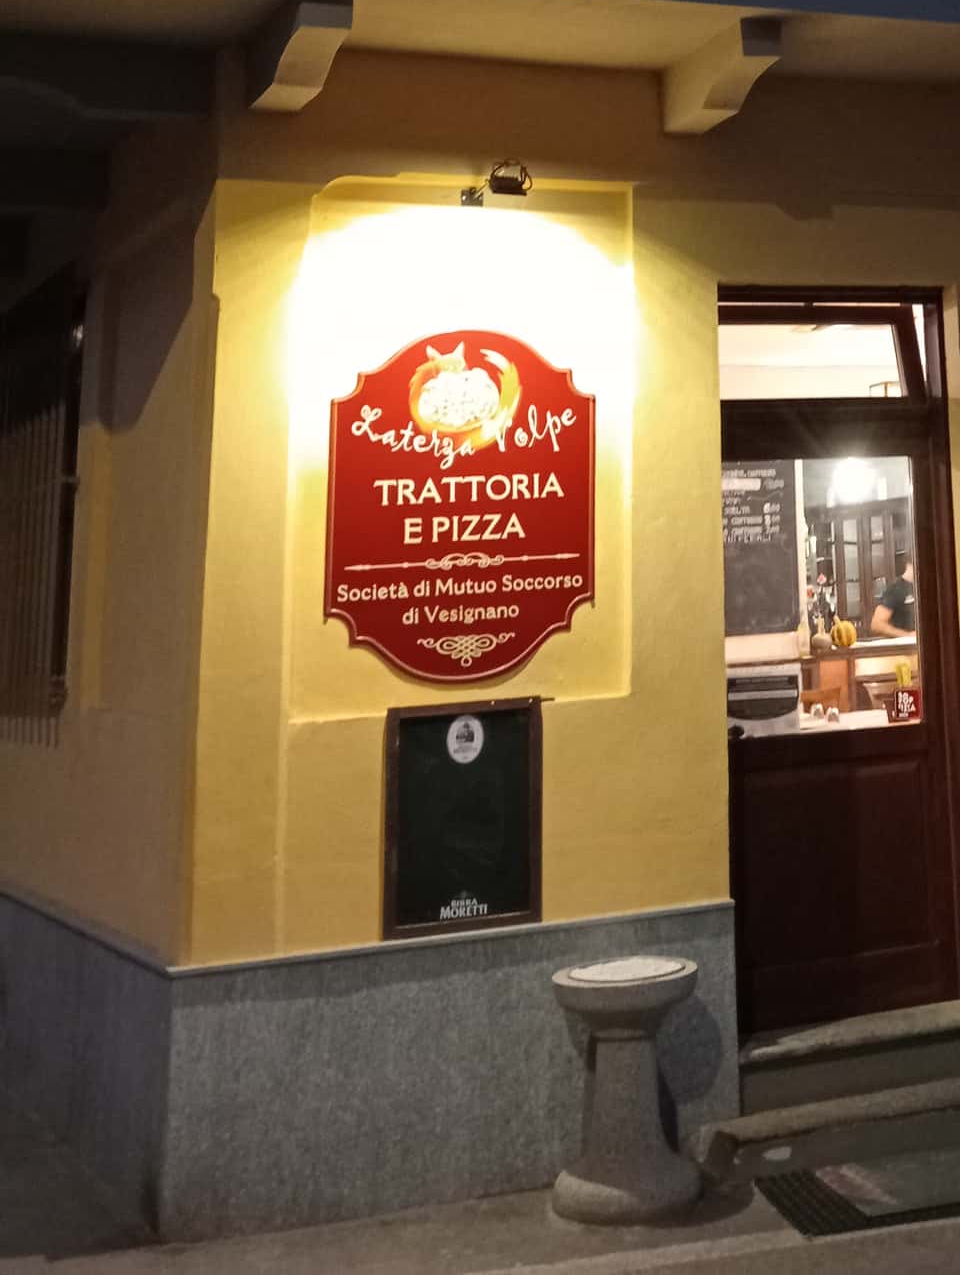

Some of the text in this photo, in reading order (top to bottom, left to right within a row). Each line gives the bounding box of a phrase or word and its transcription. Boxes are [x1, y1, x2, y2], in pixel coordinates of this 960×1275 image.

[483, 403, 577, 453] Volpe
[373, 472, 564, 506] TRATTORIA
[403, 512, 526, 545] E PIZZA
[337, 574, 584, 603] Società di Mutuo Soccorso
[402, 603, 520, 625] di Vesignano
[440, 903, 488, 920] MORETTI
